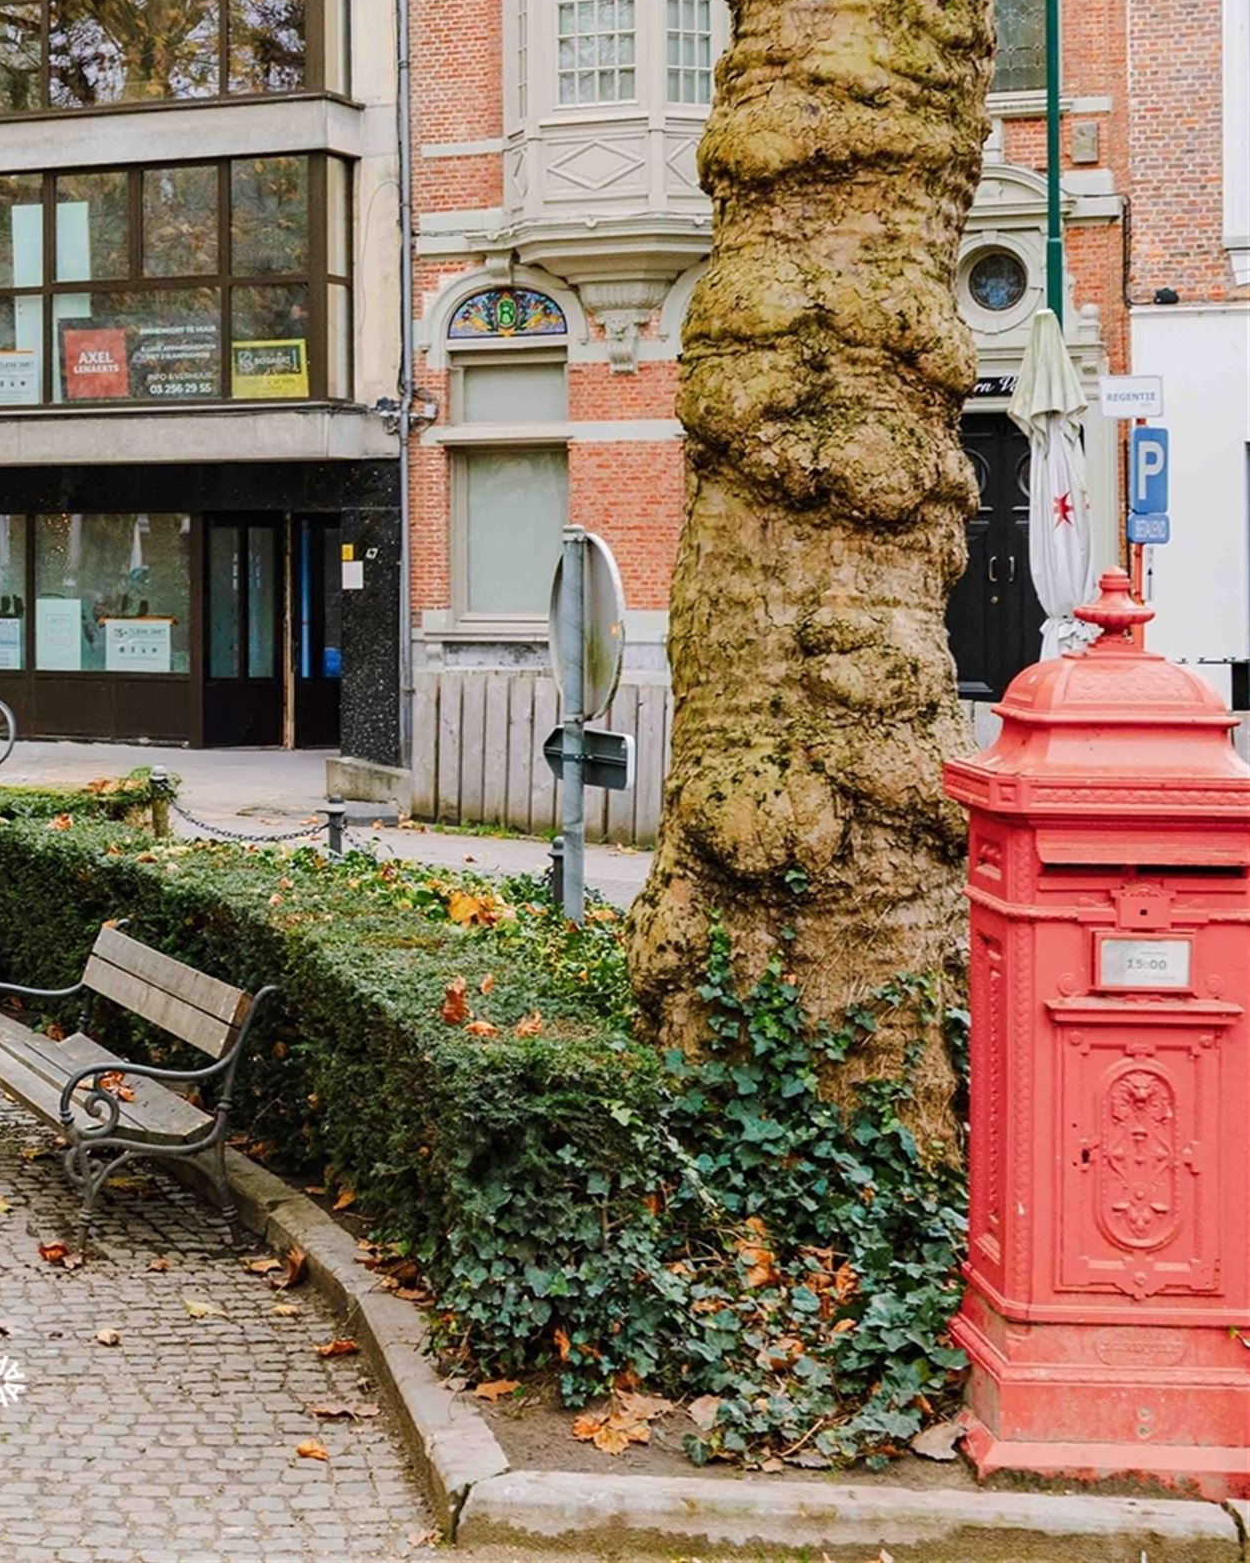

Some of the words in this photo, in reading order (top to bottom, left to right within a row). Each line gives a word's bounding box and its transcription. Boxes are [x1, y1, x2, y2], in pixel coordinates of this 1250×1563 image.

[79, 351, 114, 364] AXEL
[73, 363, 120, 374] LENAERTS
[150, 384, 163, 394] 03
[164, 384, 183, 393] 256
[184, 383, 198, 393] 29
[199, 382, 212, 393] 55
[1106, 392, 1156, 401] REGENTIE
[1139, 441, 1165, 500] P
[1127, 958, 1167, 970] 15:00
